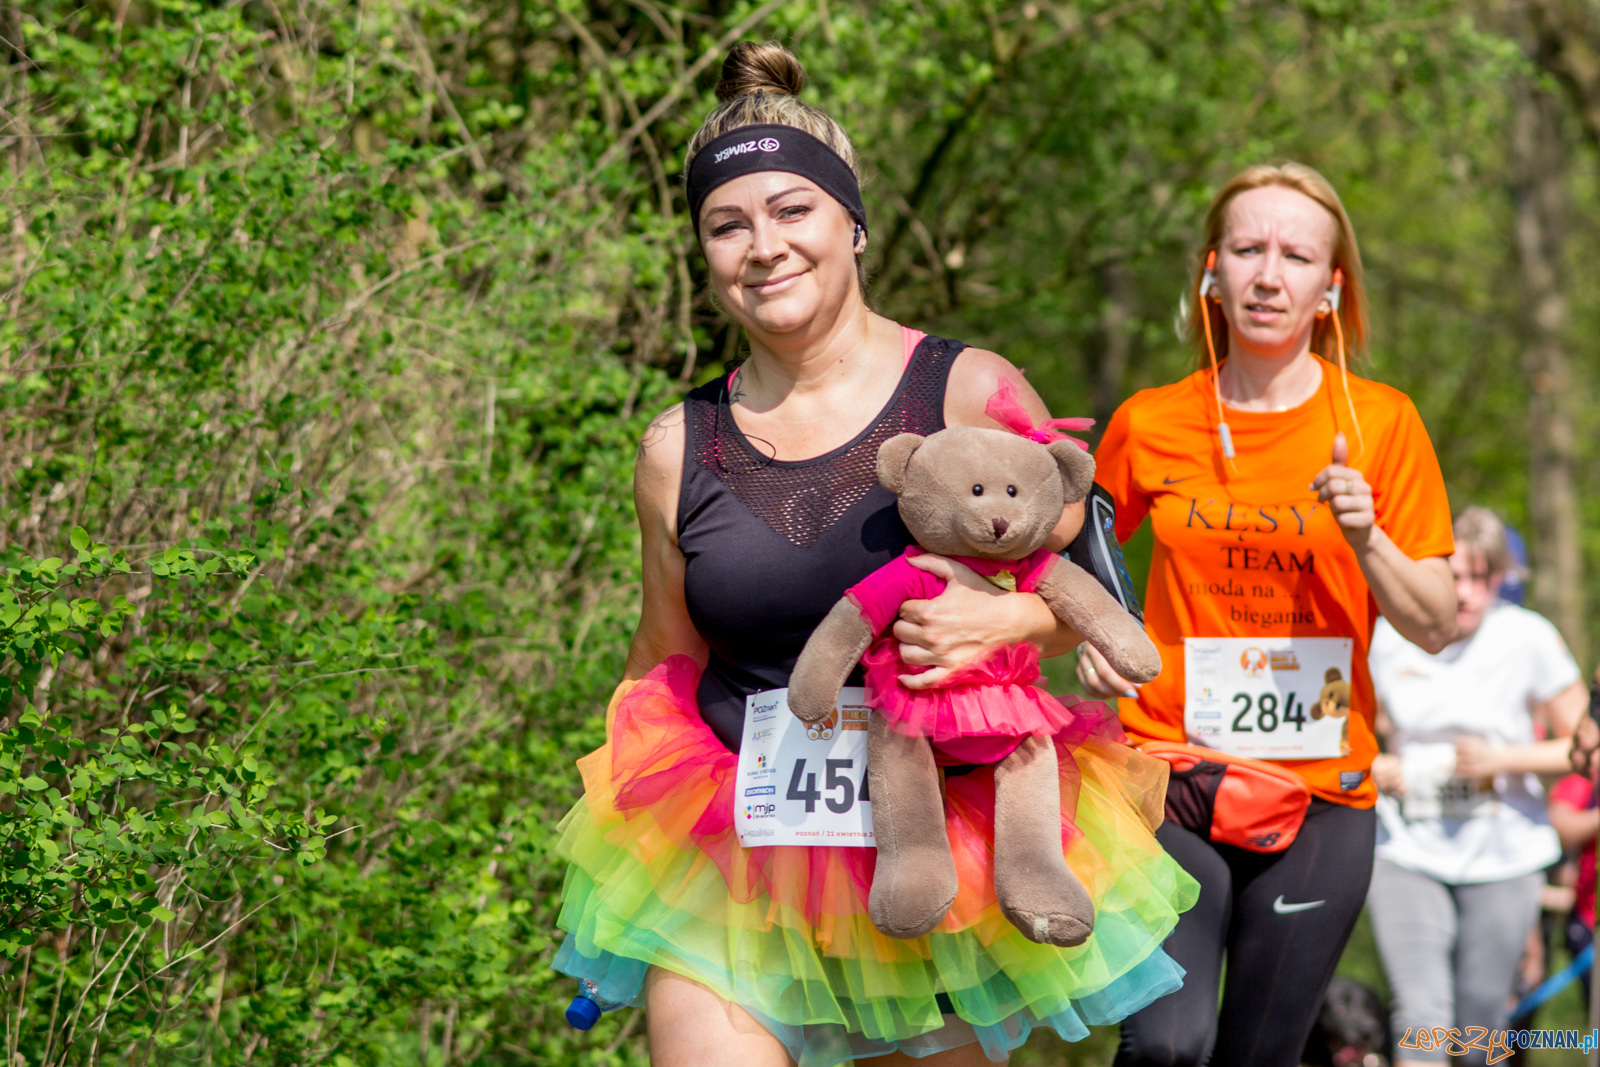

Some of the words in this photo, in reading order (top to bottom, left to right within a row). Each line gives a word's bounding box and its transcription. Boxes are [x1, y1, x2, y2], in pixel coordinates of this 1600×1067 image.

[714, 140, 758, 163] ZUMBA
[1186, 498, 1317, 541] KĘSY
[1220, 546, 1315, 574] TEAM
[1189, 579, 1244, 597] moda
[1252, 584, 1275, 598] na
[1230, 604, 1315, 629] bieganie
[1231, 691, 1307, 733] 284
[755, 803, 775, 814] mjp
